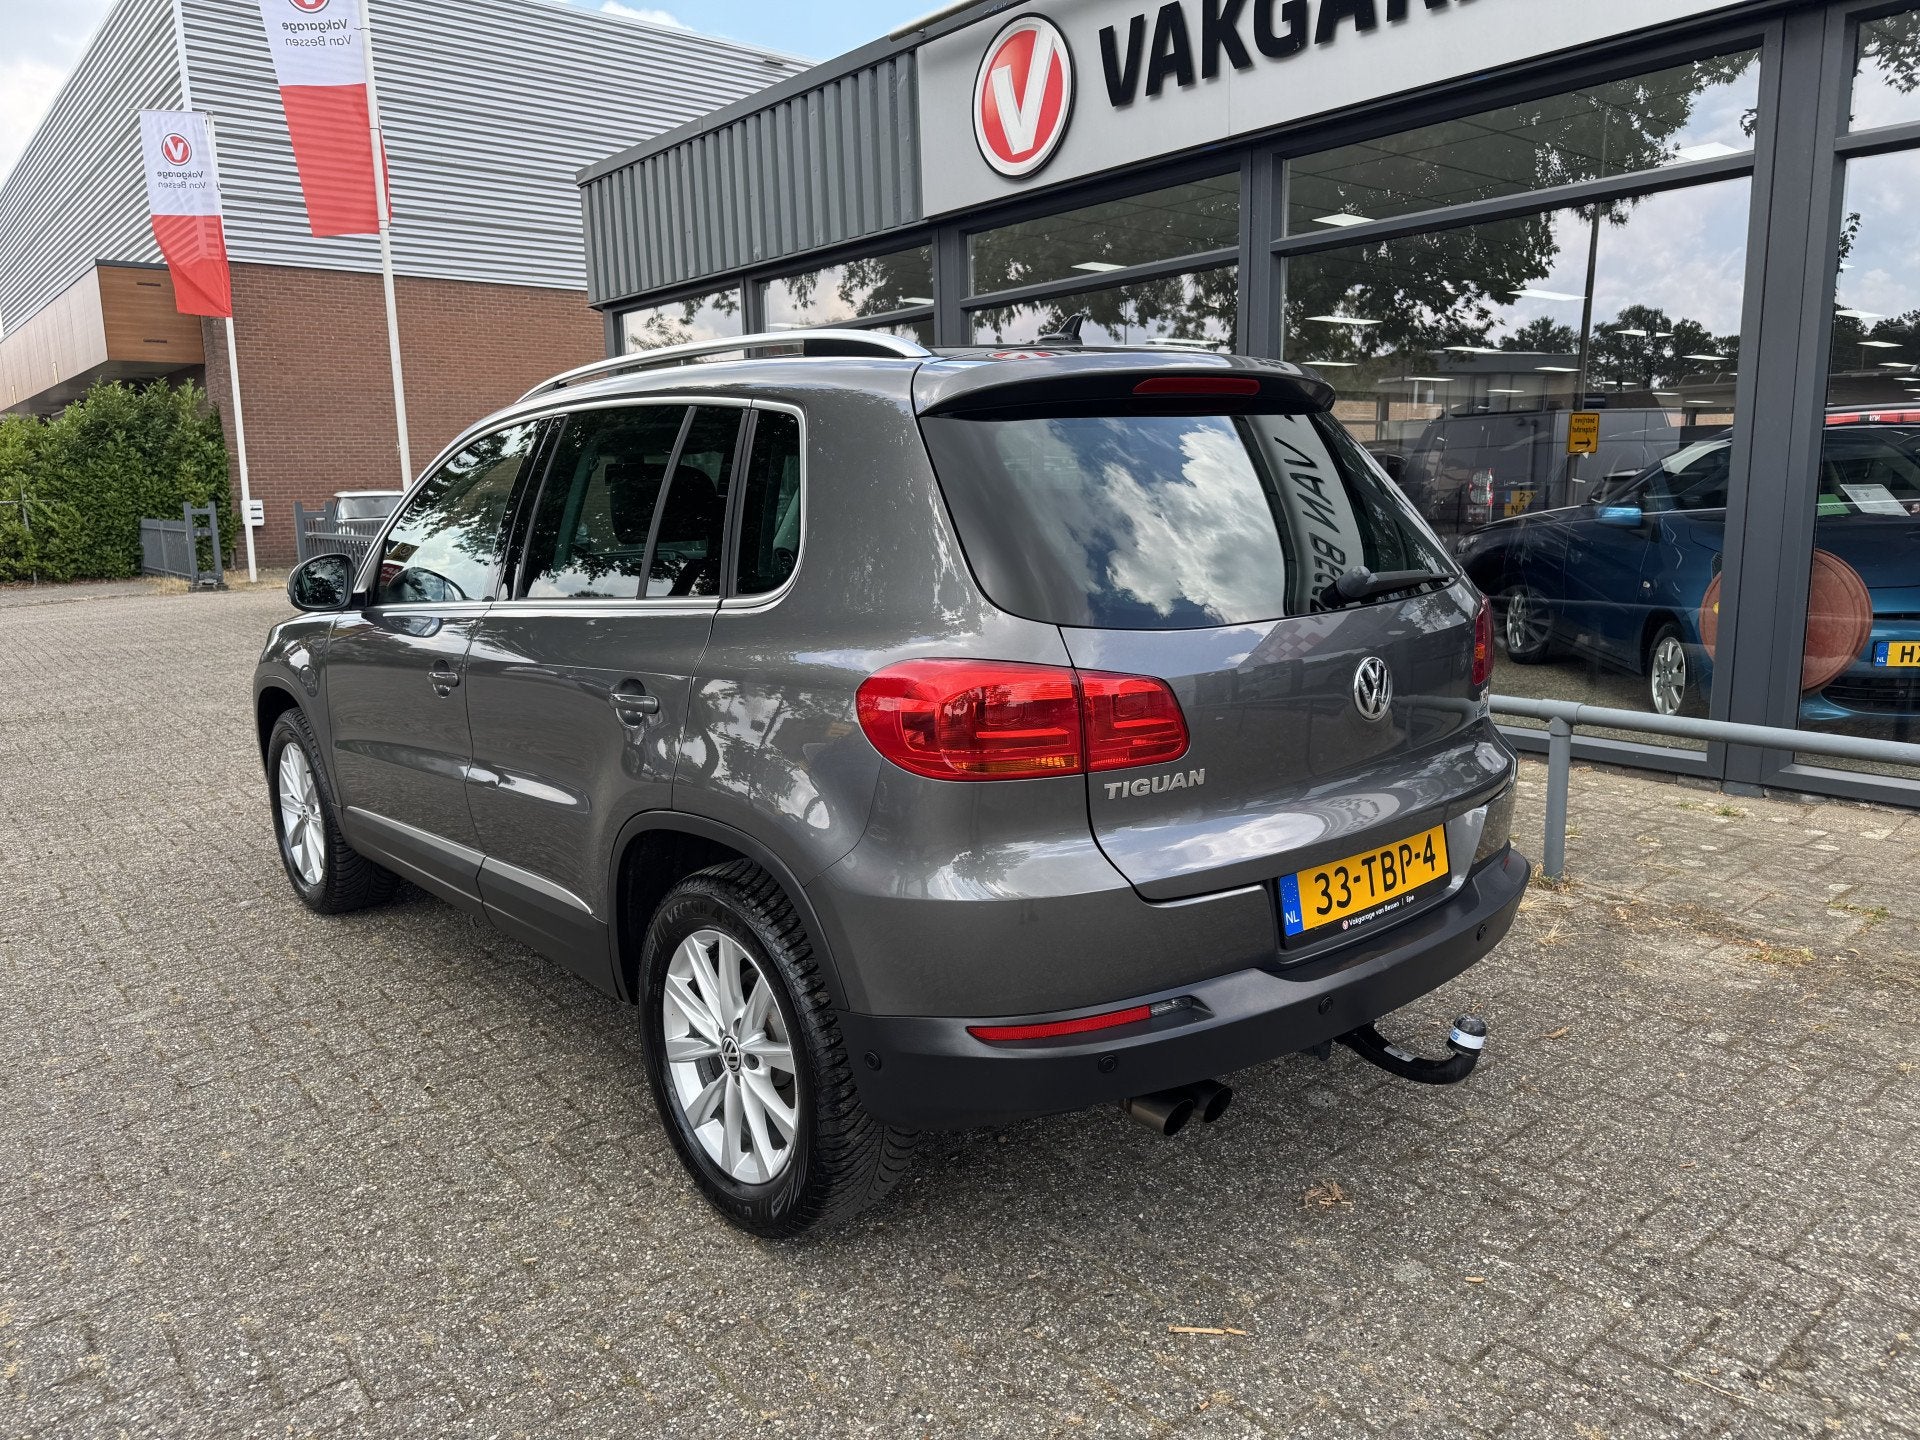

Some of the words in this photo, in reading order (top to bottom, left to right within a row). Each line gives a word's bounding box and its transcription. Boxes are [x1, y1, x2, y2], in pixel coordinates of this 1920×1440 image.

[1099, 0, 1449, 107] VAKGA
[1900, 645, 1920, 663] H
[1103, 769, 1206, 800] TIGUAN
[1285, 910, 1300, 926] NL
[1314, 833, 1436, 916] 33-TBP-4
[1348, 911, 1376, 927] Vakgarage
[1384, 901, 1400, 913] Bessen
[1405, 895, 1415, 904] Epe
